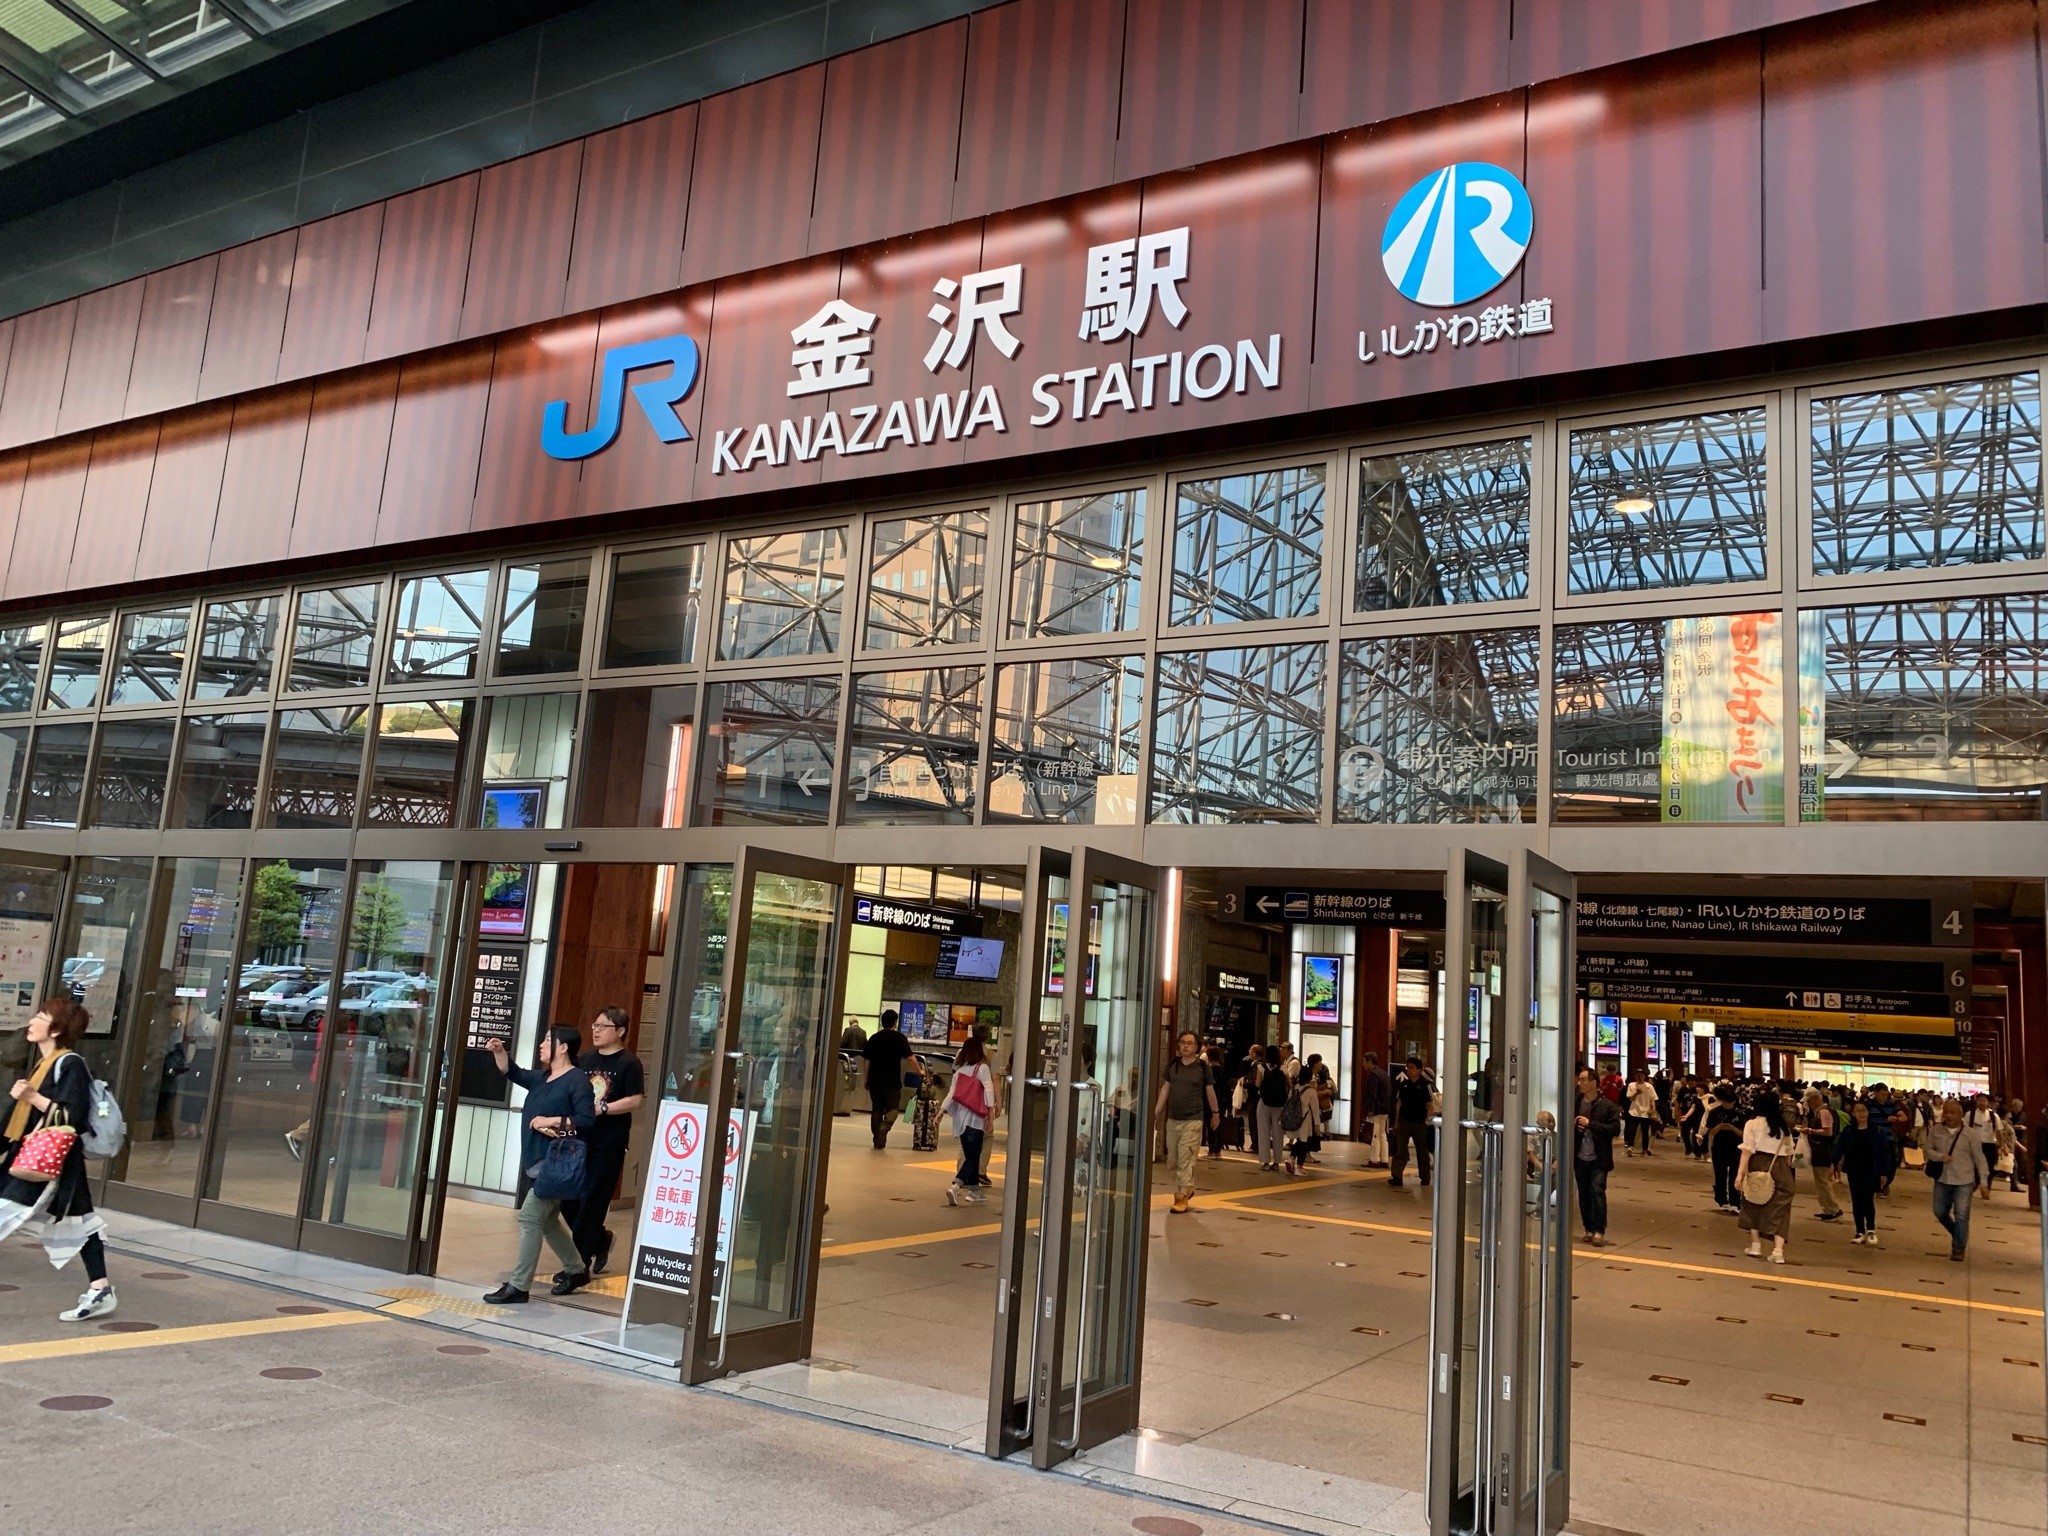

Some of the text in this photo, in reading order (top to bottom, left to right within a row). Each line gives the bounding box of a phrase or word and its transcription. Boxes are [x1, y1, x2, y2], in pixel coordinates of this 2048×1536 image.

[786, 226, 1191, 397] 金沢駅
[1359, 297, 1554, 362] いしかわ鉄道
[541, 334, 701, 461] JR
[711, 333, 1283, 476] KANAZAWA STATION
[1398, 744, 1538, 769] 観光案内所
[1558, 746, 1772, 767] Tourist Infmatn
[1575, 773, 1659, 788] 觀光問訊處
[1224, 893, 1237, 914] 3
[1313, 894, 1393, 909] 新幹線のりば
[872, 904, 932, 929] 新幹線のりば
[1313, 908, 1367, 919] Shinkansen
[1942, 910, 1963, 935] 4
[1596, 918, 1643, 929] (Hokuriku
[1646, 919, 1669, 930] Line,
[1672, 920, 1705, 930] Nanao
[1708, 921, 1735, 931] Line),
[1738, 922, 1749, 931] IR
[1751, 922, 1798, 932] Ishikawa
[1800, 923, 1843, 935] Railway
[1434, 950, 1444, 965] 5
[1950, 969, 1966, 987] 6
[483, 993, 512, 1001] コインロッカー
[1844, 995, 1873, 1004] お手洗
[1877, 997, 1910, 1006] Restroom
[1610, 1003, 1618, 1014] 9
[1955, 1000, 1966, 1014] 8
[1956, 1020, 1972, 1033] 10
[644, 1253, 655, 1264] No
[657, 1255, 686, 1271] bicycles
[643, 1265, 690, 1284] in the conco
